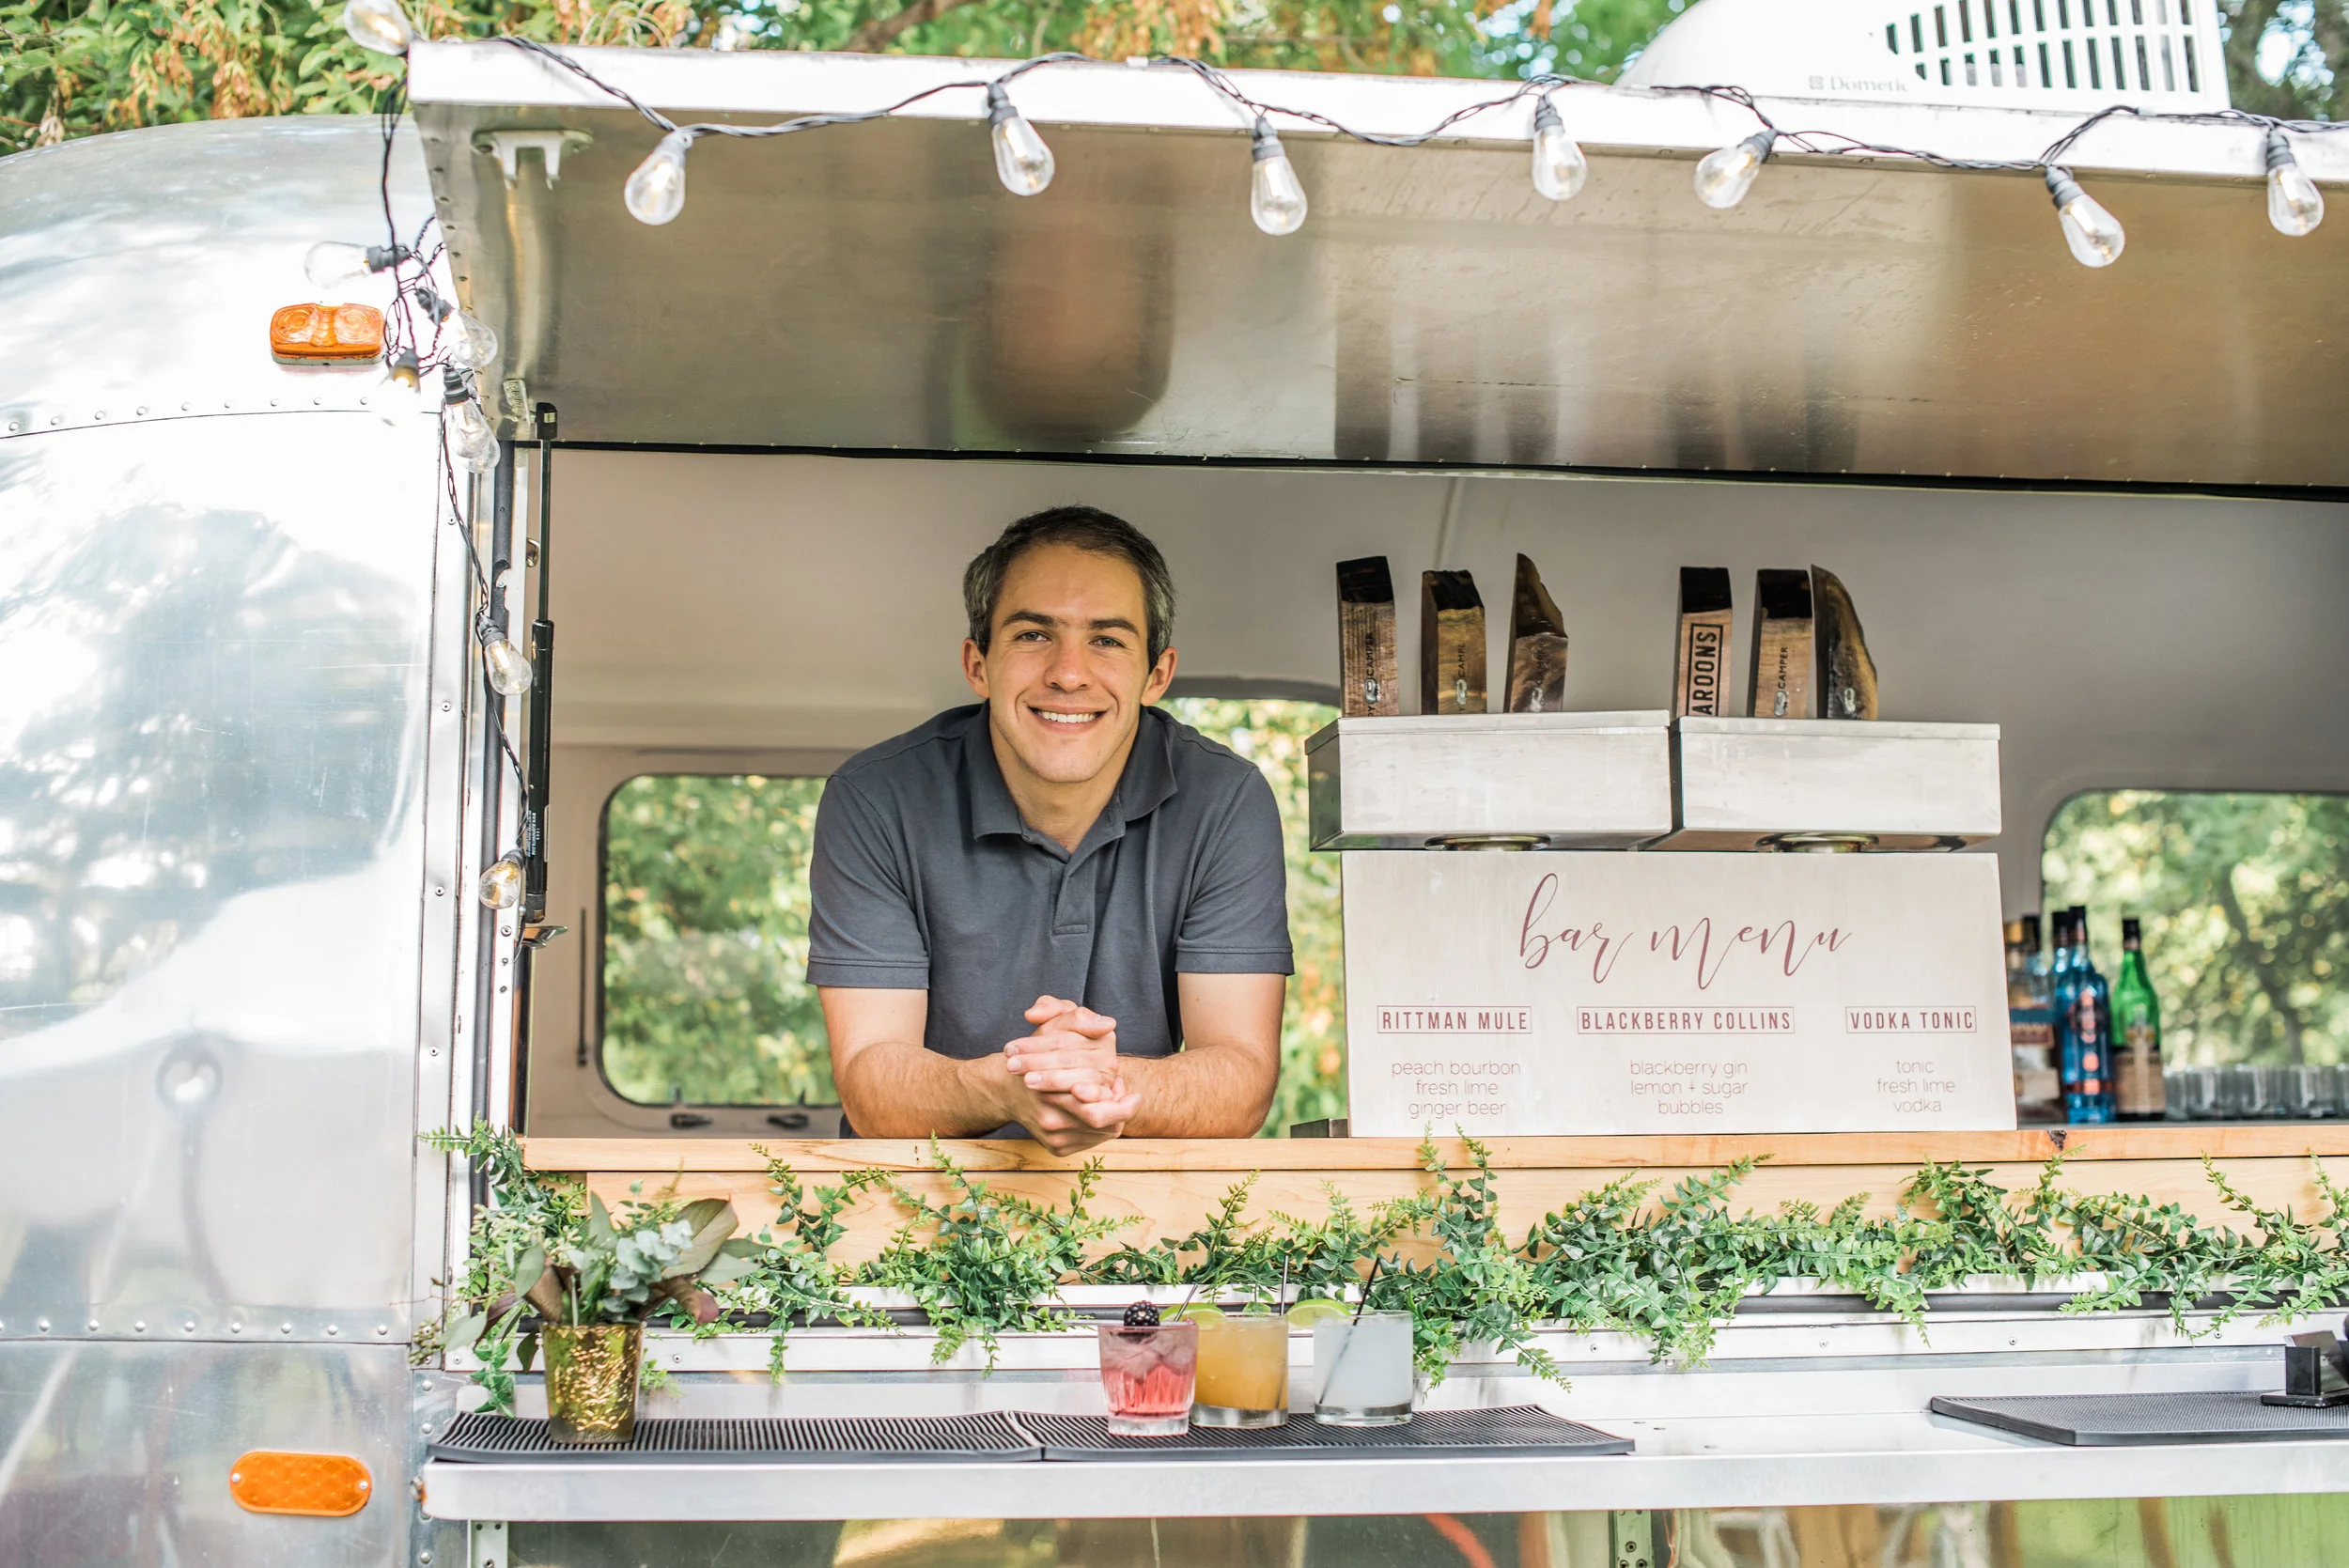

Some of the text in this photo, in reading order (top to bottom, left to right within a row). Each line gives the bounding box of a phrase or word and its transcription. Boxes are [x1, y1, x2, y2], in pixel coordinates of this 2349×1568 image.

[1364, 632, 1376, 676] CAMPER
[1777, 646, 1789, 690] CAMPER
[1519, 872, 1853, 990] bar menu
[1382, 1010, 1528, 1031] RITTMAN MULE
[1580, 1011, 1792, 1031] BLACKBERRY COLLINS
[1850, 1011, 1974, 1031] VODKA TONIC
[1392, 1060, 1521, 1078] peach bourbon
[1630, 1059, 1748, 1079] blackberry gin
[1896, 1059, 1935, 1074] tonic
[1416, 1079, 1499, 1095] fresh lime
[1630, 1079, 1749, 1099] lemon + sugar
[1877, 1078, 1956, 1094] fresh lime
[1408, 1100, 1506, 1119] ginger beer
[1657, 1099, 1724, 1115] bubbles
[1892, 1097, 1942, 1113] vodka
